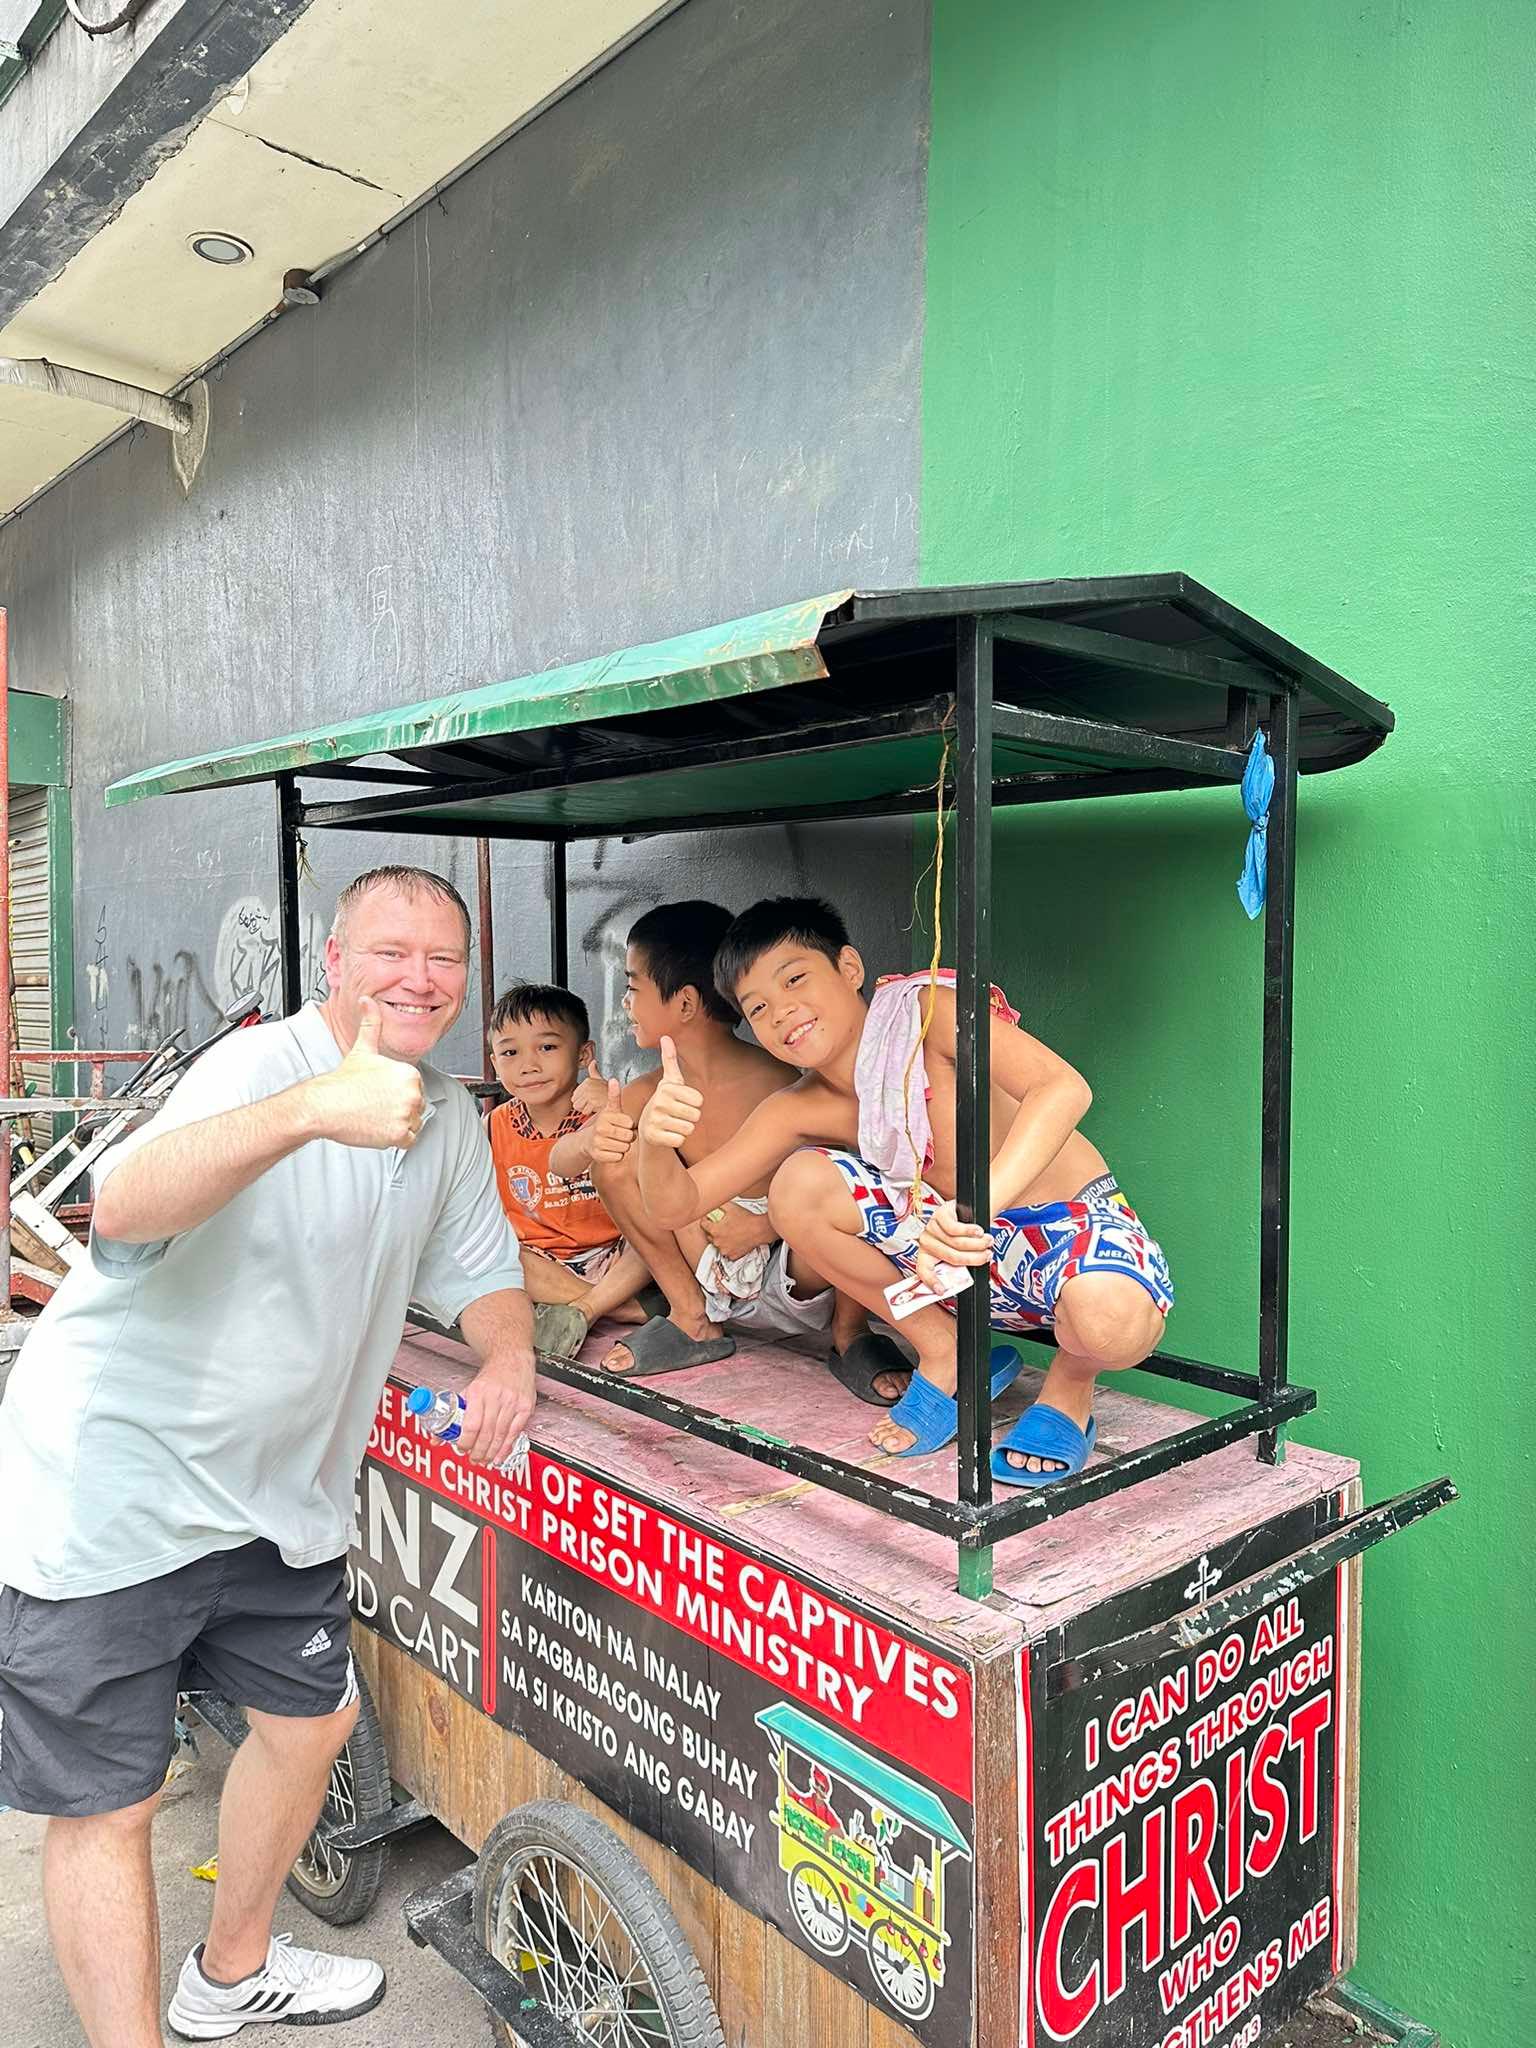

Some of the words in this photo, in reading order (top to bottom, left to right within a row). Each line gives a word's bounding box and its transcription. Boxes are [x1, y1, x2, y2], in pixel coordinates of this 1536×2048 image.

[1097, 1249, 1134, 1263] NBA
[346, 1561, 378, 1619] D
[390, 1594, 480, 1694] CART
[355, 1464, 480, 1628] NZ
[367, 1423, 432, 1478] OUGH
[440, 1459, 533, 1530] CHRIST
[542, 1512, 663, 1606] PRISON
[675, 1583, 874, 1723] MINISTRY
[541, 1464, 583, 1513] OF
[592, 1488, 647, 1547] SET
[657, 1519, 725, 1592] THE
[738, 1564, 959, 1719] CAPTIVES
[501, 1608, 523, 1647] SA
[528, 1624, 676, 1746] PAGBABAGONG
[682, 1723, 758, 1800] BUHAY
[521, 1573, 601, 1648] KARITON
[607, 1624, 638, 1671] NA
[644, 1646, 722, 1722] INALAY
[1085, 1717, 1100, 1771] I
[1107, 1666, 1189, 1751] CAN
[1195, 1633, 1244, 1702] DO
[1250, 1596, 1304, 1665] ALL
[503, 1655, 529, 1698] NA
[532, 1676, 548, 1711] SI
[552, 1688, 618, 1758] KRISTO
[624, 1740, 672, 1795] ANG
[677, 1776, 756, 1854] GABAY
[1044, 1737, 1181, 1867] THINGS
[1186, 1635, 1333, 1768] THROUGH
[1036, 1690, 1332, 2042] CHRIST
[1152, 1938, 1283, 2048] GTHENS
[1287, 1895, 1331, 1969] ME
[1158, 1915, 1241, 2015] WHO
